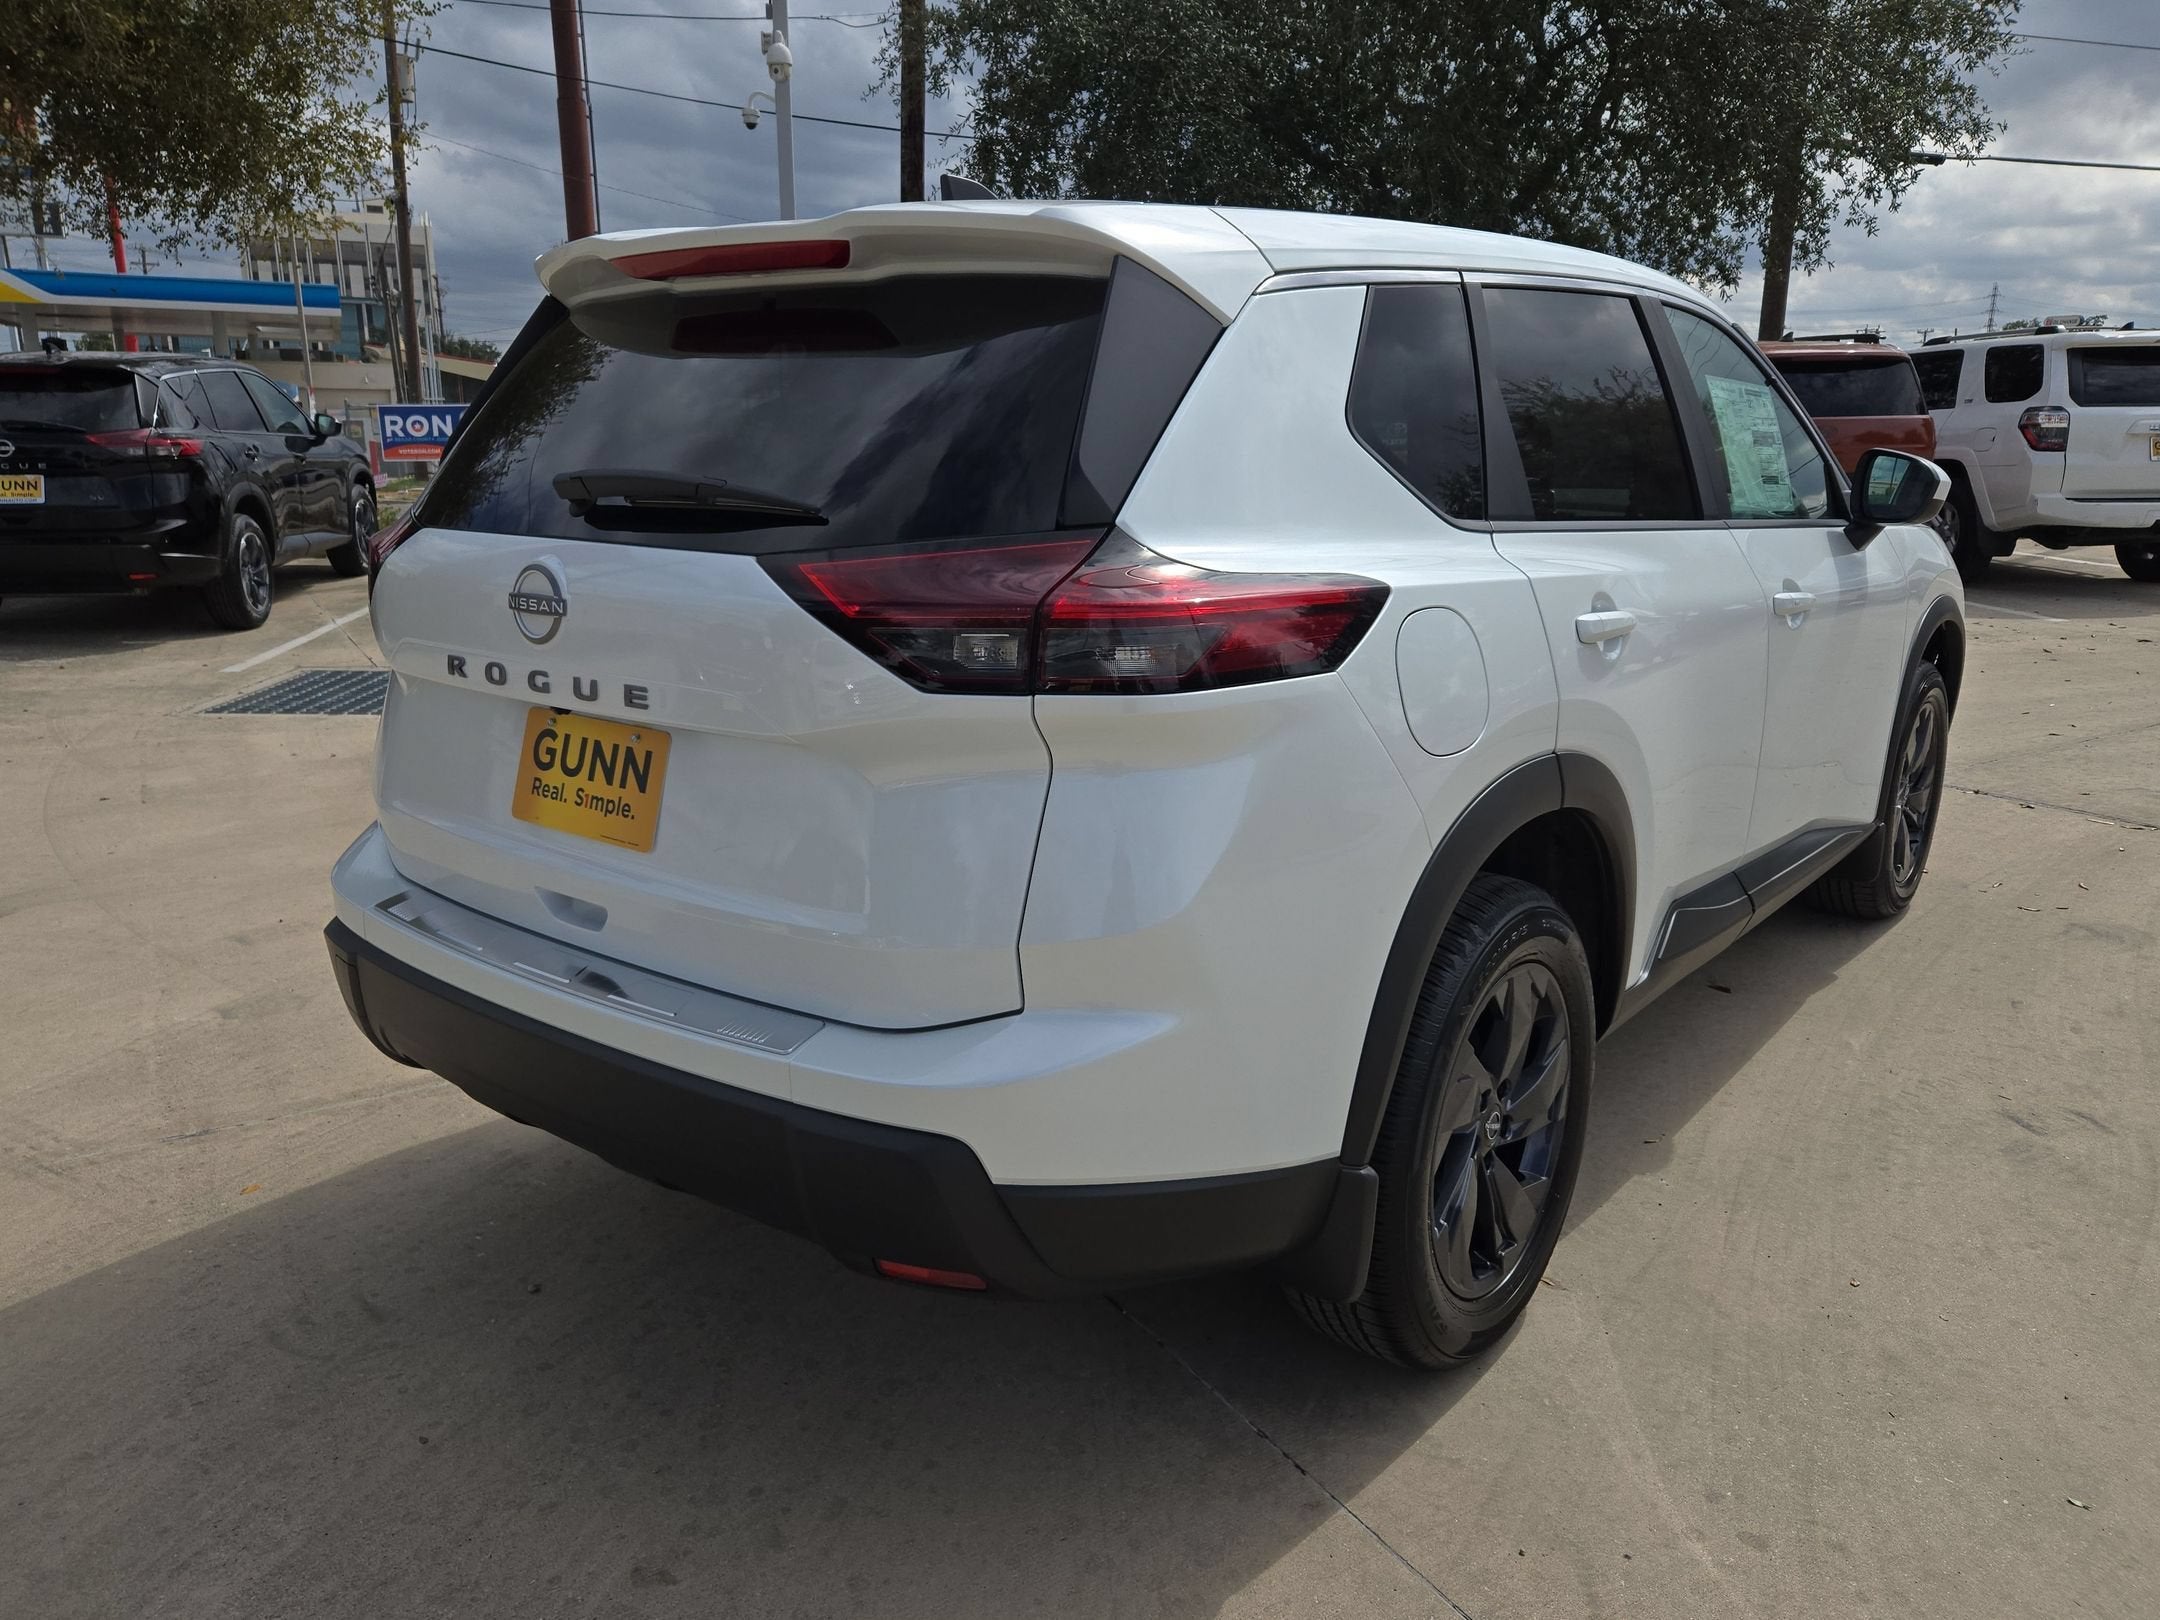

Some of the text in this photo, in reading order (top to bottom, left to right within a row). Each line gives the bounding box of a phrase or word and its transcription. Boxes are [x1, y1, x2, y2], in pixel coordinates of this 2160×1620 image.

[384, 414, 453, 438] RON
[1, 480, 38, 491] UNN
[510, 595, 564, 614] NISSAN
[447, 654, 650, 710] ROGUE
[533, 728, 653, 794] GUNN
[531, 776, 567, 803] Real.
